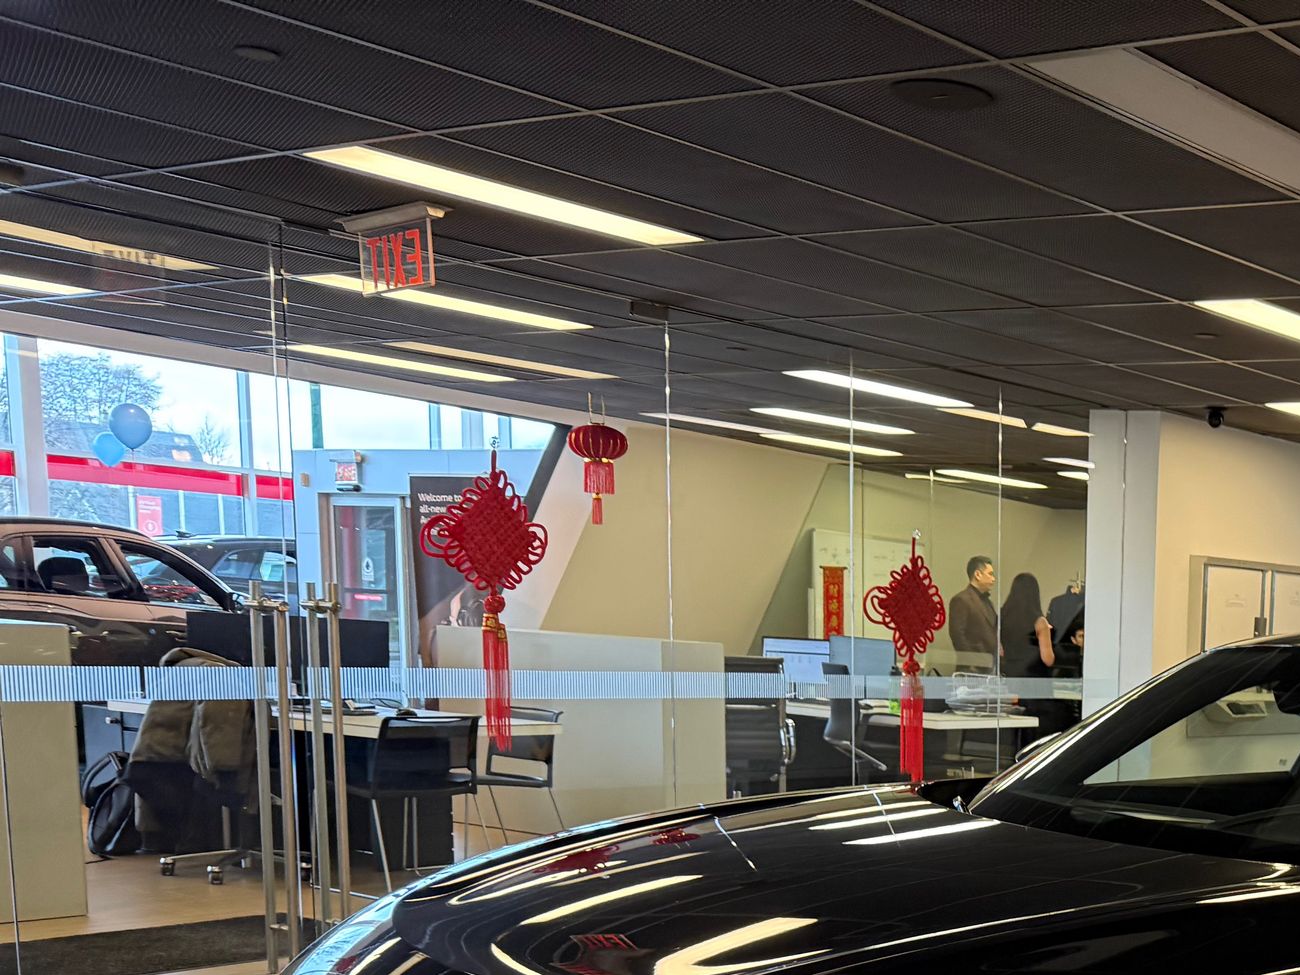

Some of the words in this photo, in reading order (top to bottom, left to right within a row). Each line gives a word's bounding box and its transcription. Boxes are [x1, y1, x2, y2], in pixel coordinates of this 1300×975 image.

[418, 493, 453, 503] Welcome
[453, 494, 464, 503] to
[419, 504, 448, 514] all-new
